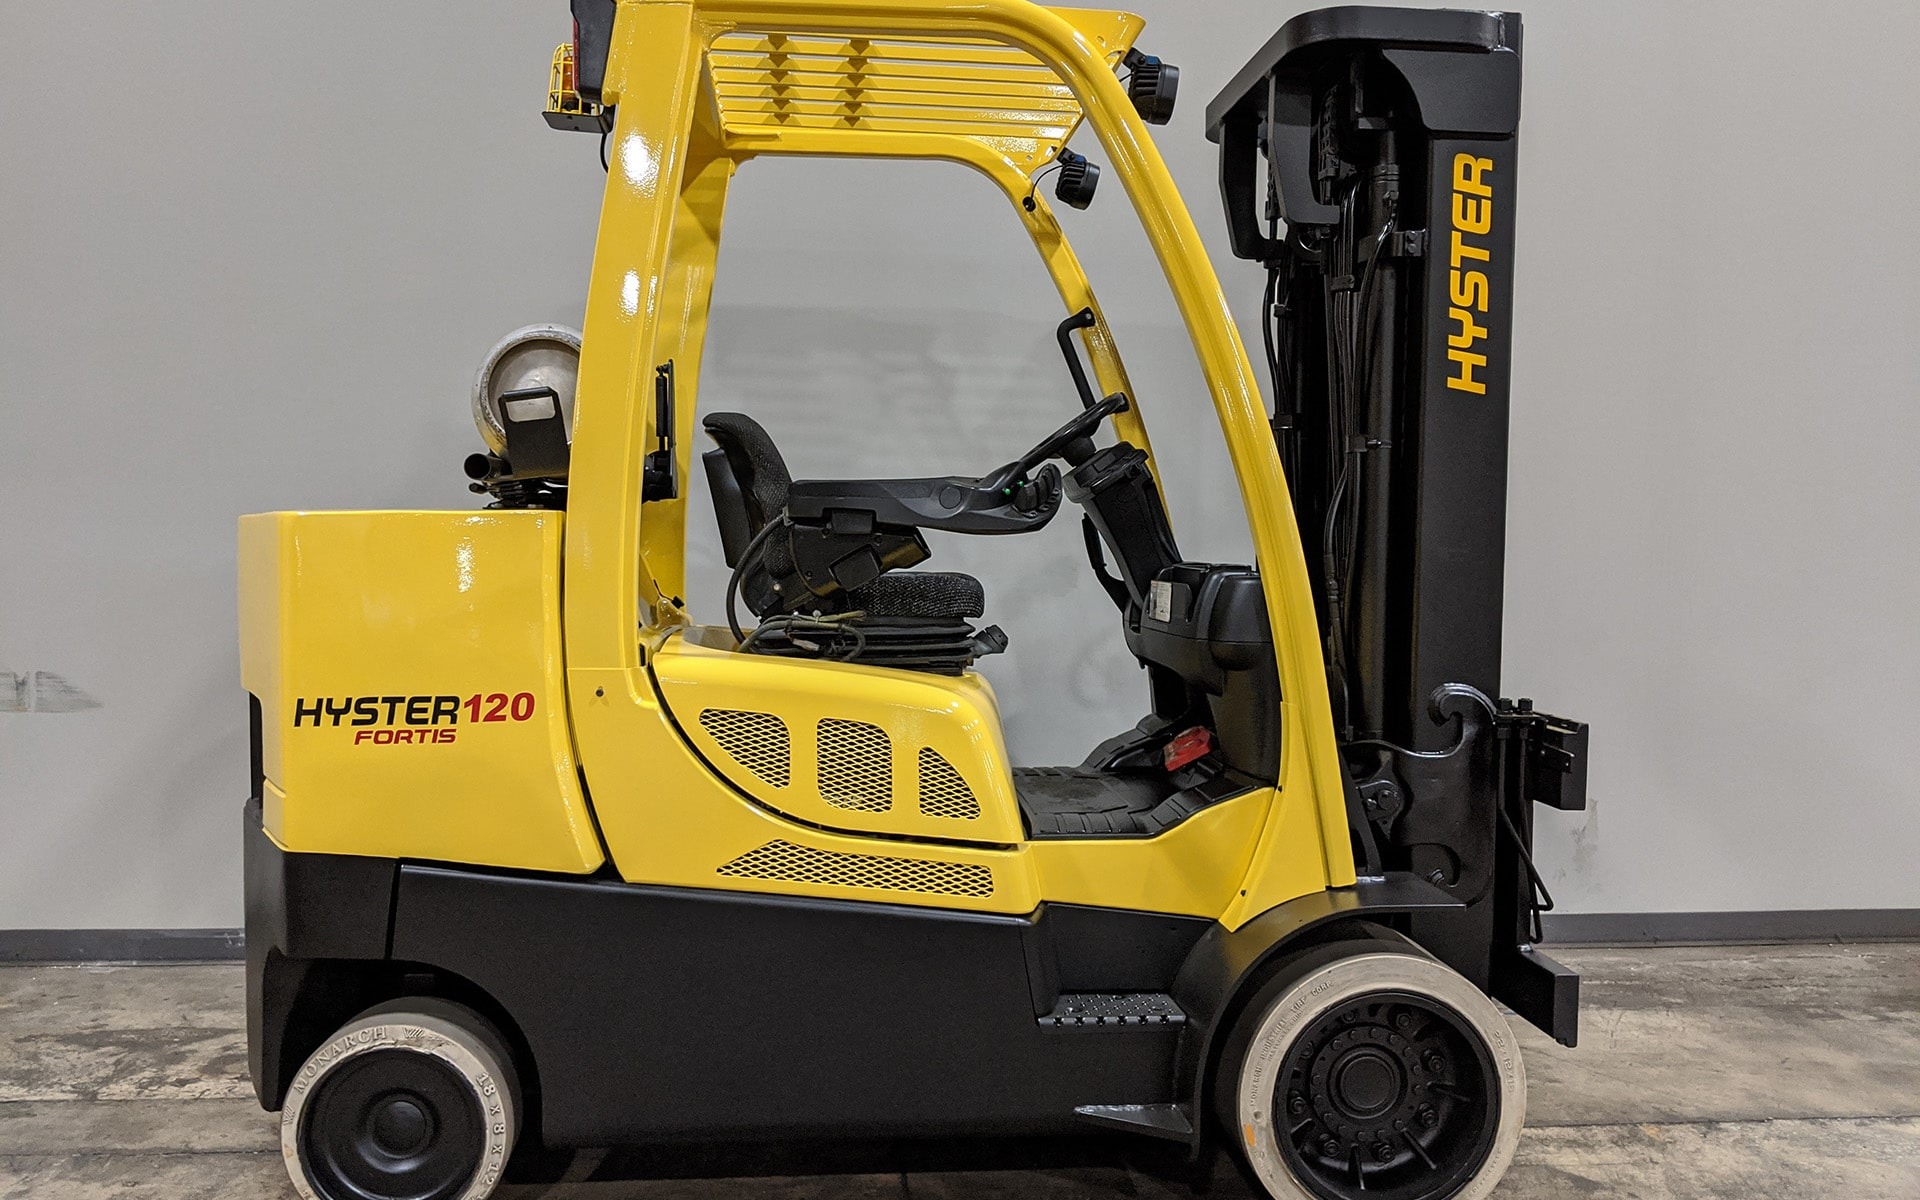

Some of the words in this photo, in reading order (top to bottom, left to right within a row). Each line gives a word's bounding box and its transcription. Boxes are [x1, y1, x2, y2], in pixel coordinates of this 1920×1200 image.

[1447, 152, 1493, 395] HYSTER
[293, 695, 461, 727] HYSTER
[463, 692, 536, 723] 120
[353, 728, 457, 746] FORTIS
[293, 1026, 388, 1095] MONARCH
